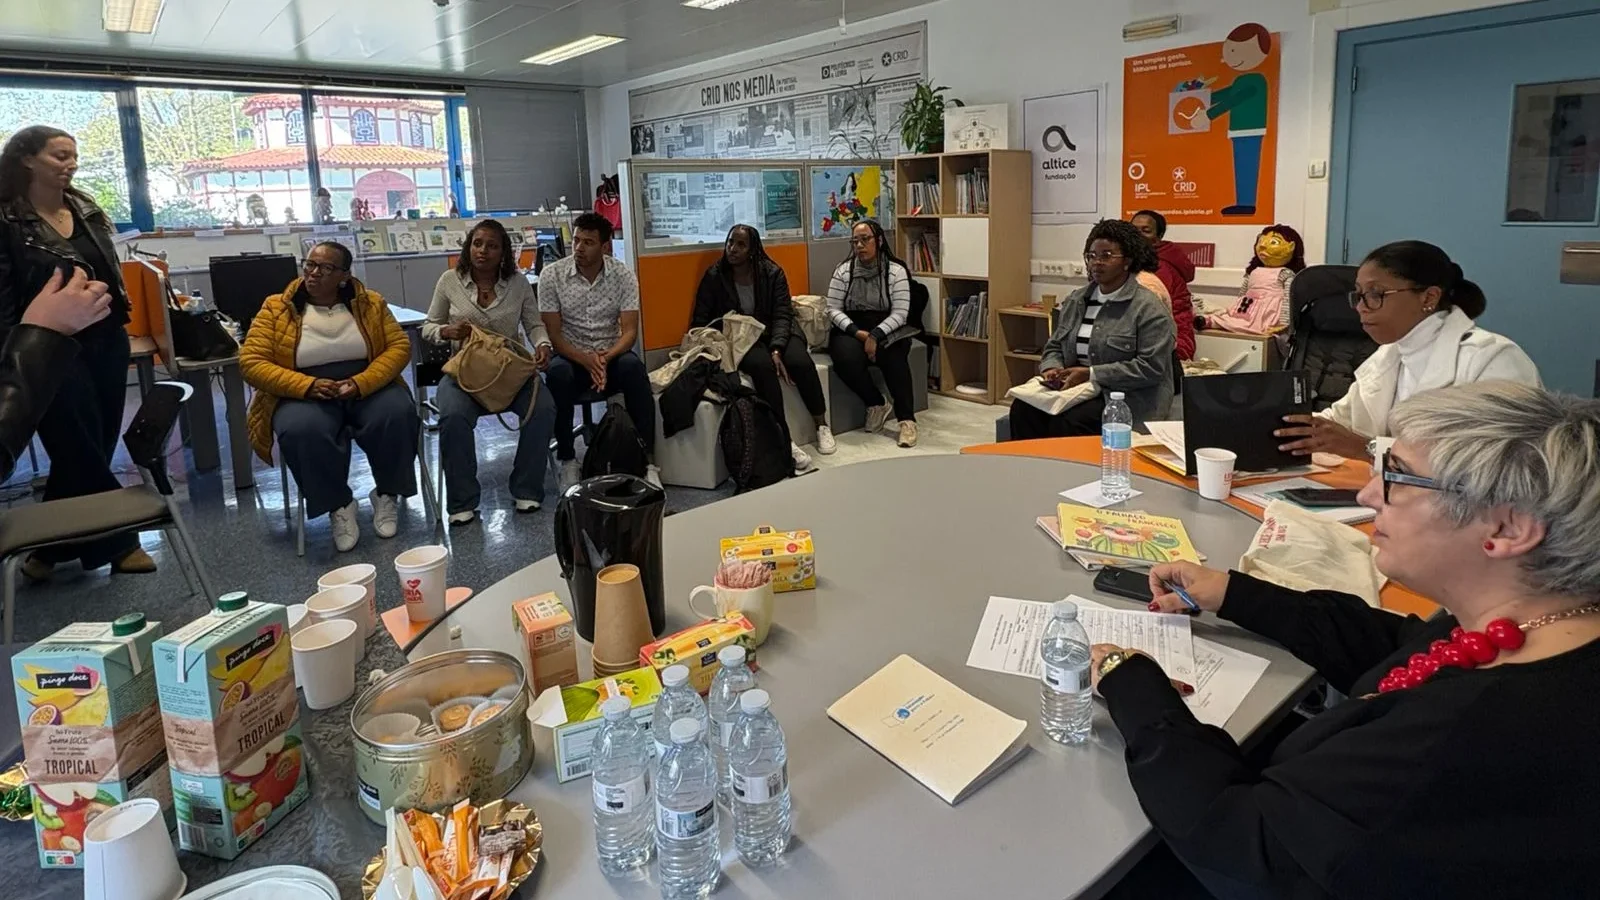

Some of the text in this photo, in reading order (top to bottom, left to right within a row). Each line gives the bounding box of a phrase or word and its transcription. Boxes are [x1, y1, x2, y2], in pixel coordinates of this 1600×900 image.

[701, 74, 775, 106] CRID NOS MEDIA
[1042, 157, 1076, 170] altice
[1045, 173, 1076, 181] fundação
[1134, 183, 1151, 192] IPL
[1173, 181, 1196, 192] CRID
[1127, 518, 1177, 529] FRANCISCO
[229, 634, 272, 669] pingo doce
[40, 672, 88, 688] pingo doce
[238, 711, 285, 753] TROPICAL
[44, 759, 99, 775] TROPICAL
